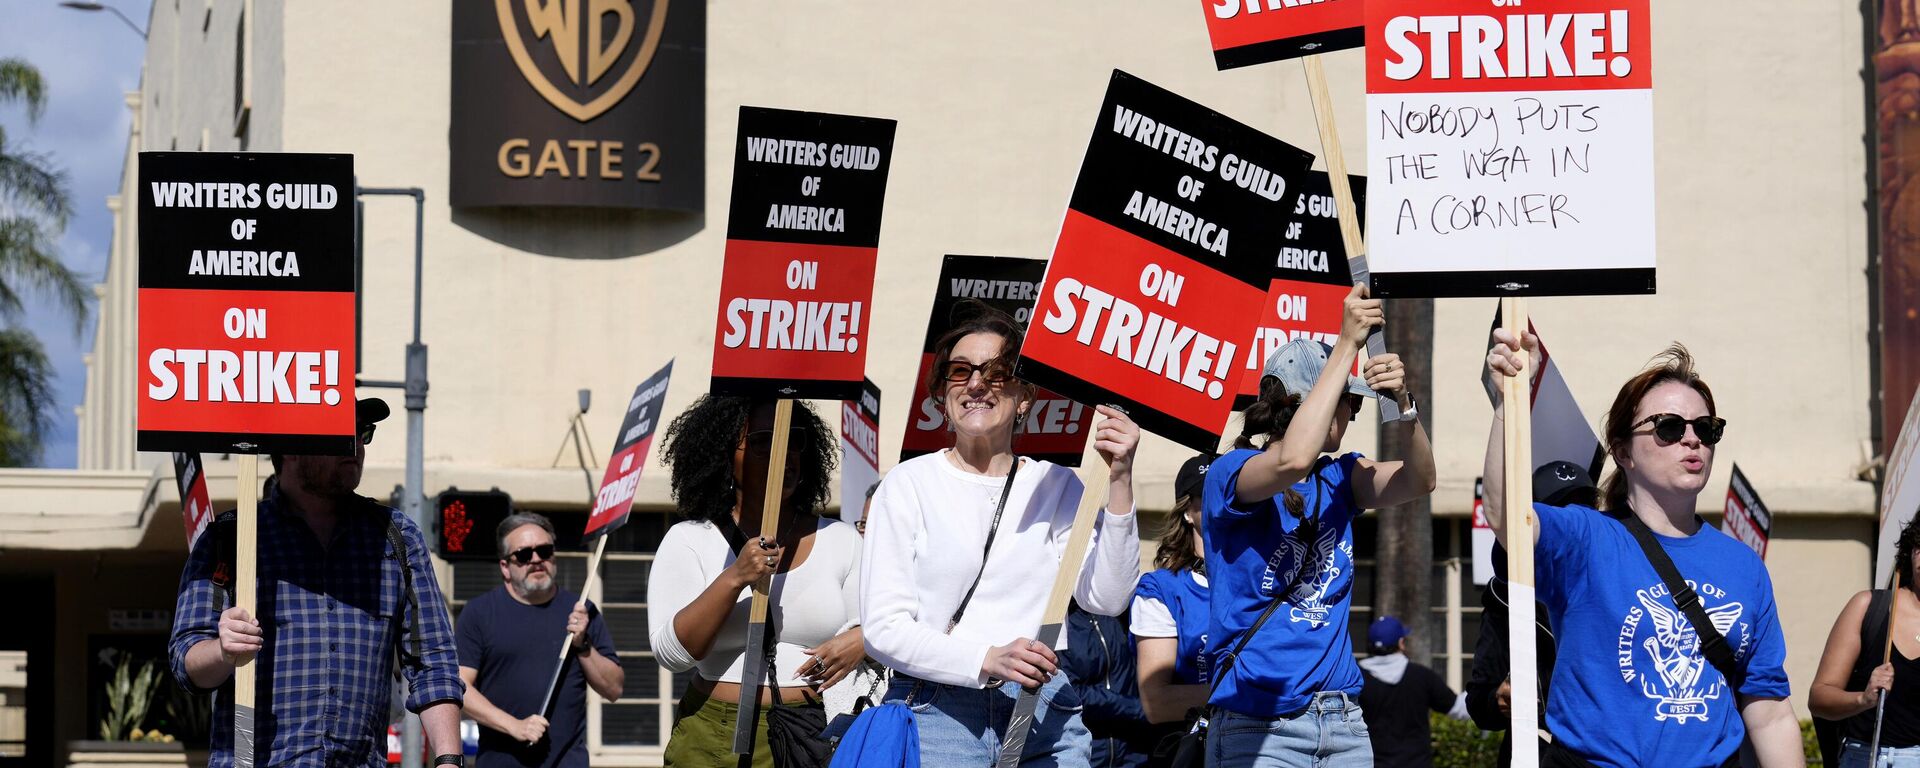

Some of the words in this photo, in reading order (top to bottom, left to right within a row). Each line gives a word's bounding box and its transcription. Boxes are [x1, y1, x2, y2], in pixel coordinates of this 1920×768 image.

[1384, 9, 1632, 80] STRIKE!
[1514, 98, 1600, 135] PUTS
[497, 138, 624, 178] GATE
[637, 142, 662, 181] 2
[747, 136, 827, 167] WRITERS
[829, 143, 881, 171] GUILD
[1113, 103, 1220, 173] WRITERS
[1218, 153, 1287, 202] GUILD
[1386, 153, 1438, 184] THE
[1463, 145, 1531, 182] WGA
[1551, 143, 1590, 177] IN
[151, 181, 262, 209] WRITERS
[266, 182, 338, 210] GUILD
[801, 175, 821, 197] OF
[1177, 174, 1205, 202] OF
[231, 218, 257, 240] OF
[766, 203, 845, 232] AMERICA
[1123, 189, 1230, 257] AMERICA
[1396, 198, 1418, 235] A
[1431, 194, 1581, 235] CORNER
[188, 250, 300, 277] AMERICA
[786, 259, 818, 290] ON
[1139, 263, 1185, 307] ON
[223, 307, 267, 339] ON
[723, 297, 862, 353] STRIKE!
[1276, 293, 1307, 322] ON
[1043, 277, 1238, 400] STRIKE!
[148, 348, 341, 406] STRIKE!
[1618, 606, 1643, 683] WRITERS
[1702, 583, 1726, 600] OF
[1669, 704, 1697, 714] WEST
